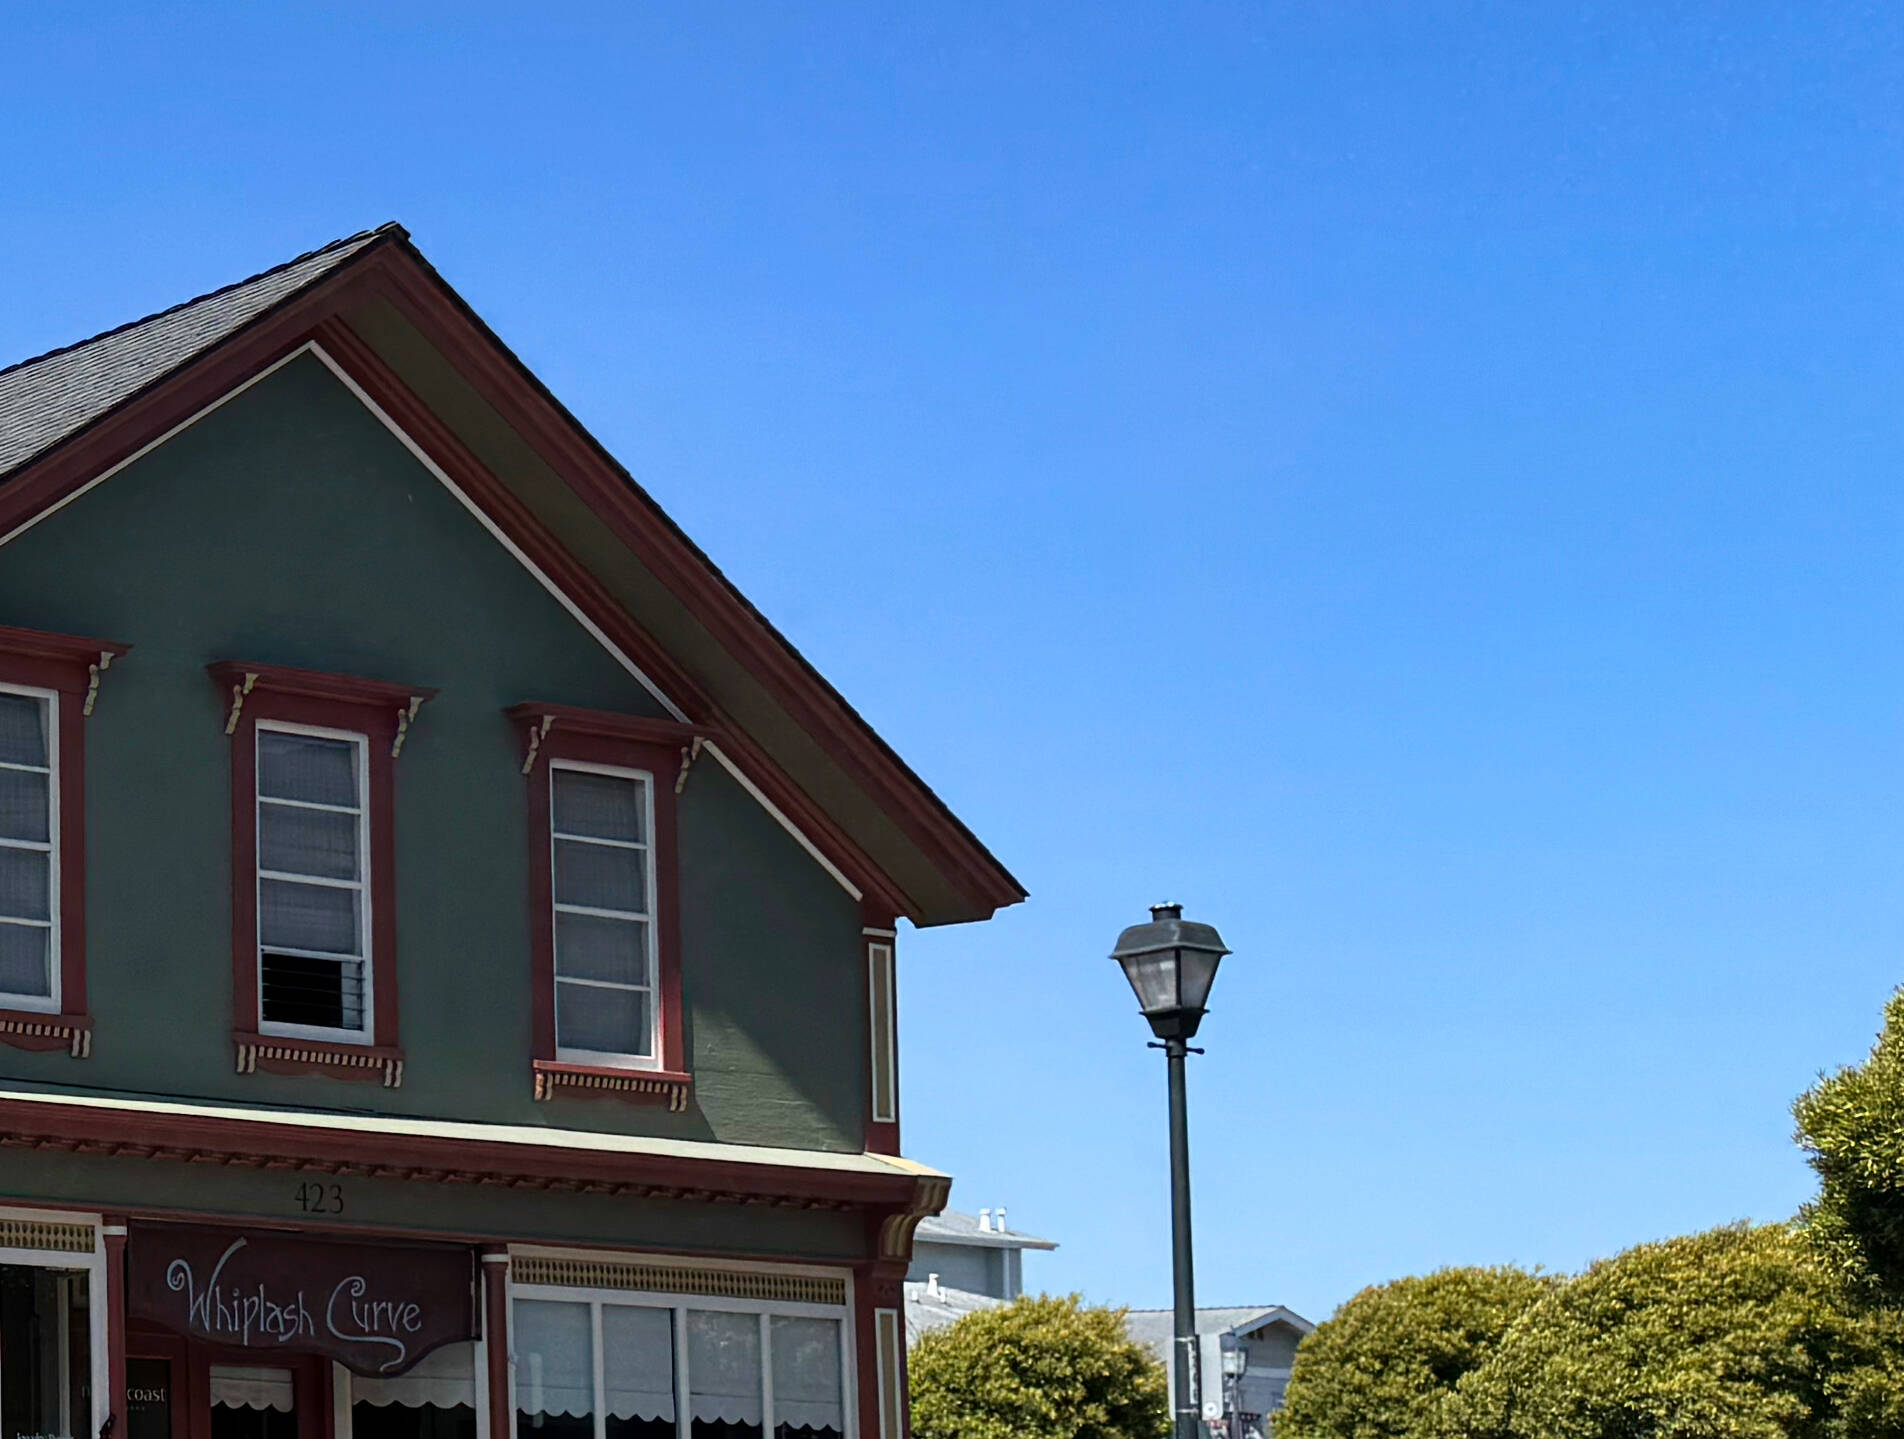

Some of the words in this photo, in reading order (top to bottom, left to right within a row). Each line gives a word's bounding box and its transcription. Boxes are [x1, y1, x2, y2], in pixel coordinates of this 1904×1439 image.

[295, 1182, 344, 1214] 423
[167, 1236, 315, 1347] Whiplash
[326, 1275, 422, 1373] Curve
[127, 1387, 167, 1402] coast
